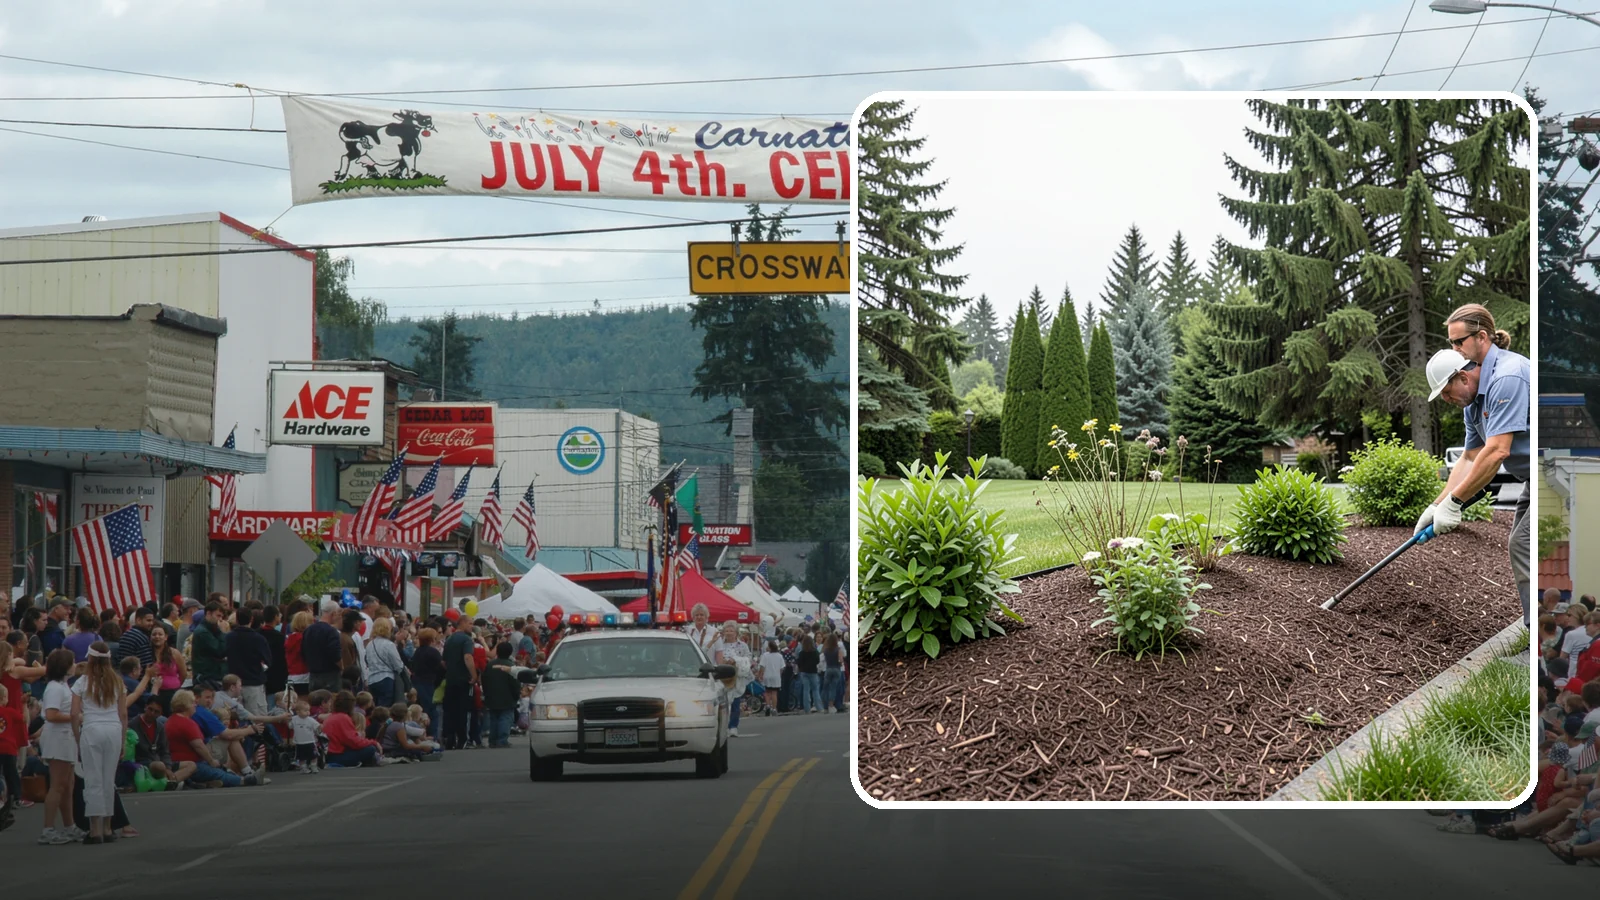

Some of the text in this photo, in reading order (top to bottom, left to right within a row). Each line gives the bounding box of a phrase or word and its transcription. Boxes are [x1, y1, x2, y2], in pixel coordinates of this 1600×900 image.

[695, 121, 850, 150] Carnat
[481, 141, 604, 192] JULY
[632, 150, 746, 198] 4th.
[696, 254, 850, 280] CROSSWA
[282, 380, 373, 420] ACE
[405, 409, 452, 422] CEDAR
[283, 421, 371, 436] Hardware
[416, 428, 476, 447] Coca-Cola
[83, 485, 155, 495] St. Vincent de Paul
[81, 503, 153, 521] THT
[212, 516, 330, 535] HARDARE
[688, 526, 741, 535] CRNATION
[699, 535, 730, 543] GLASS
